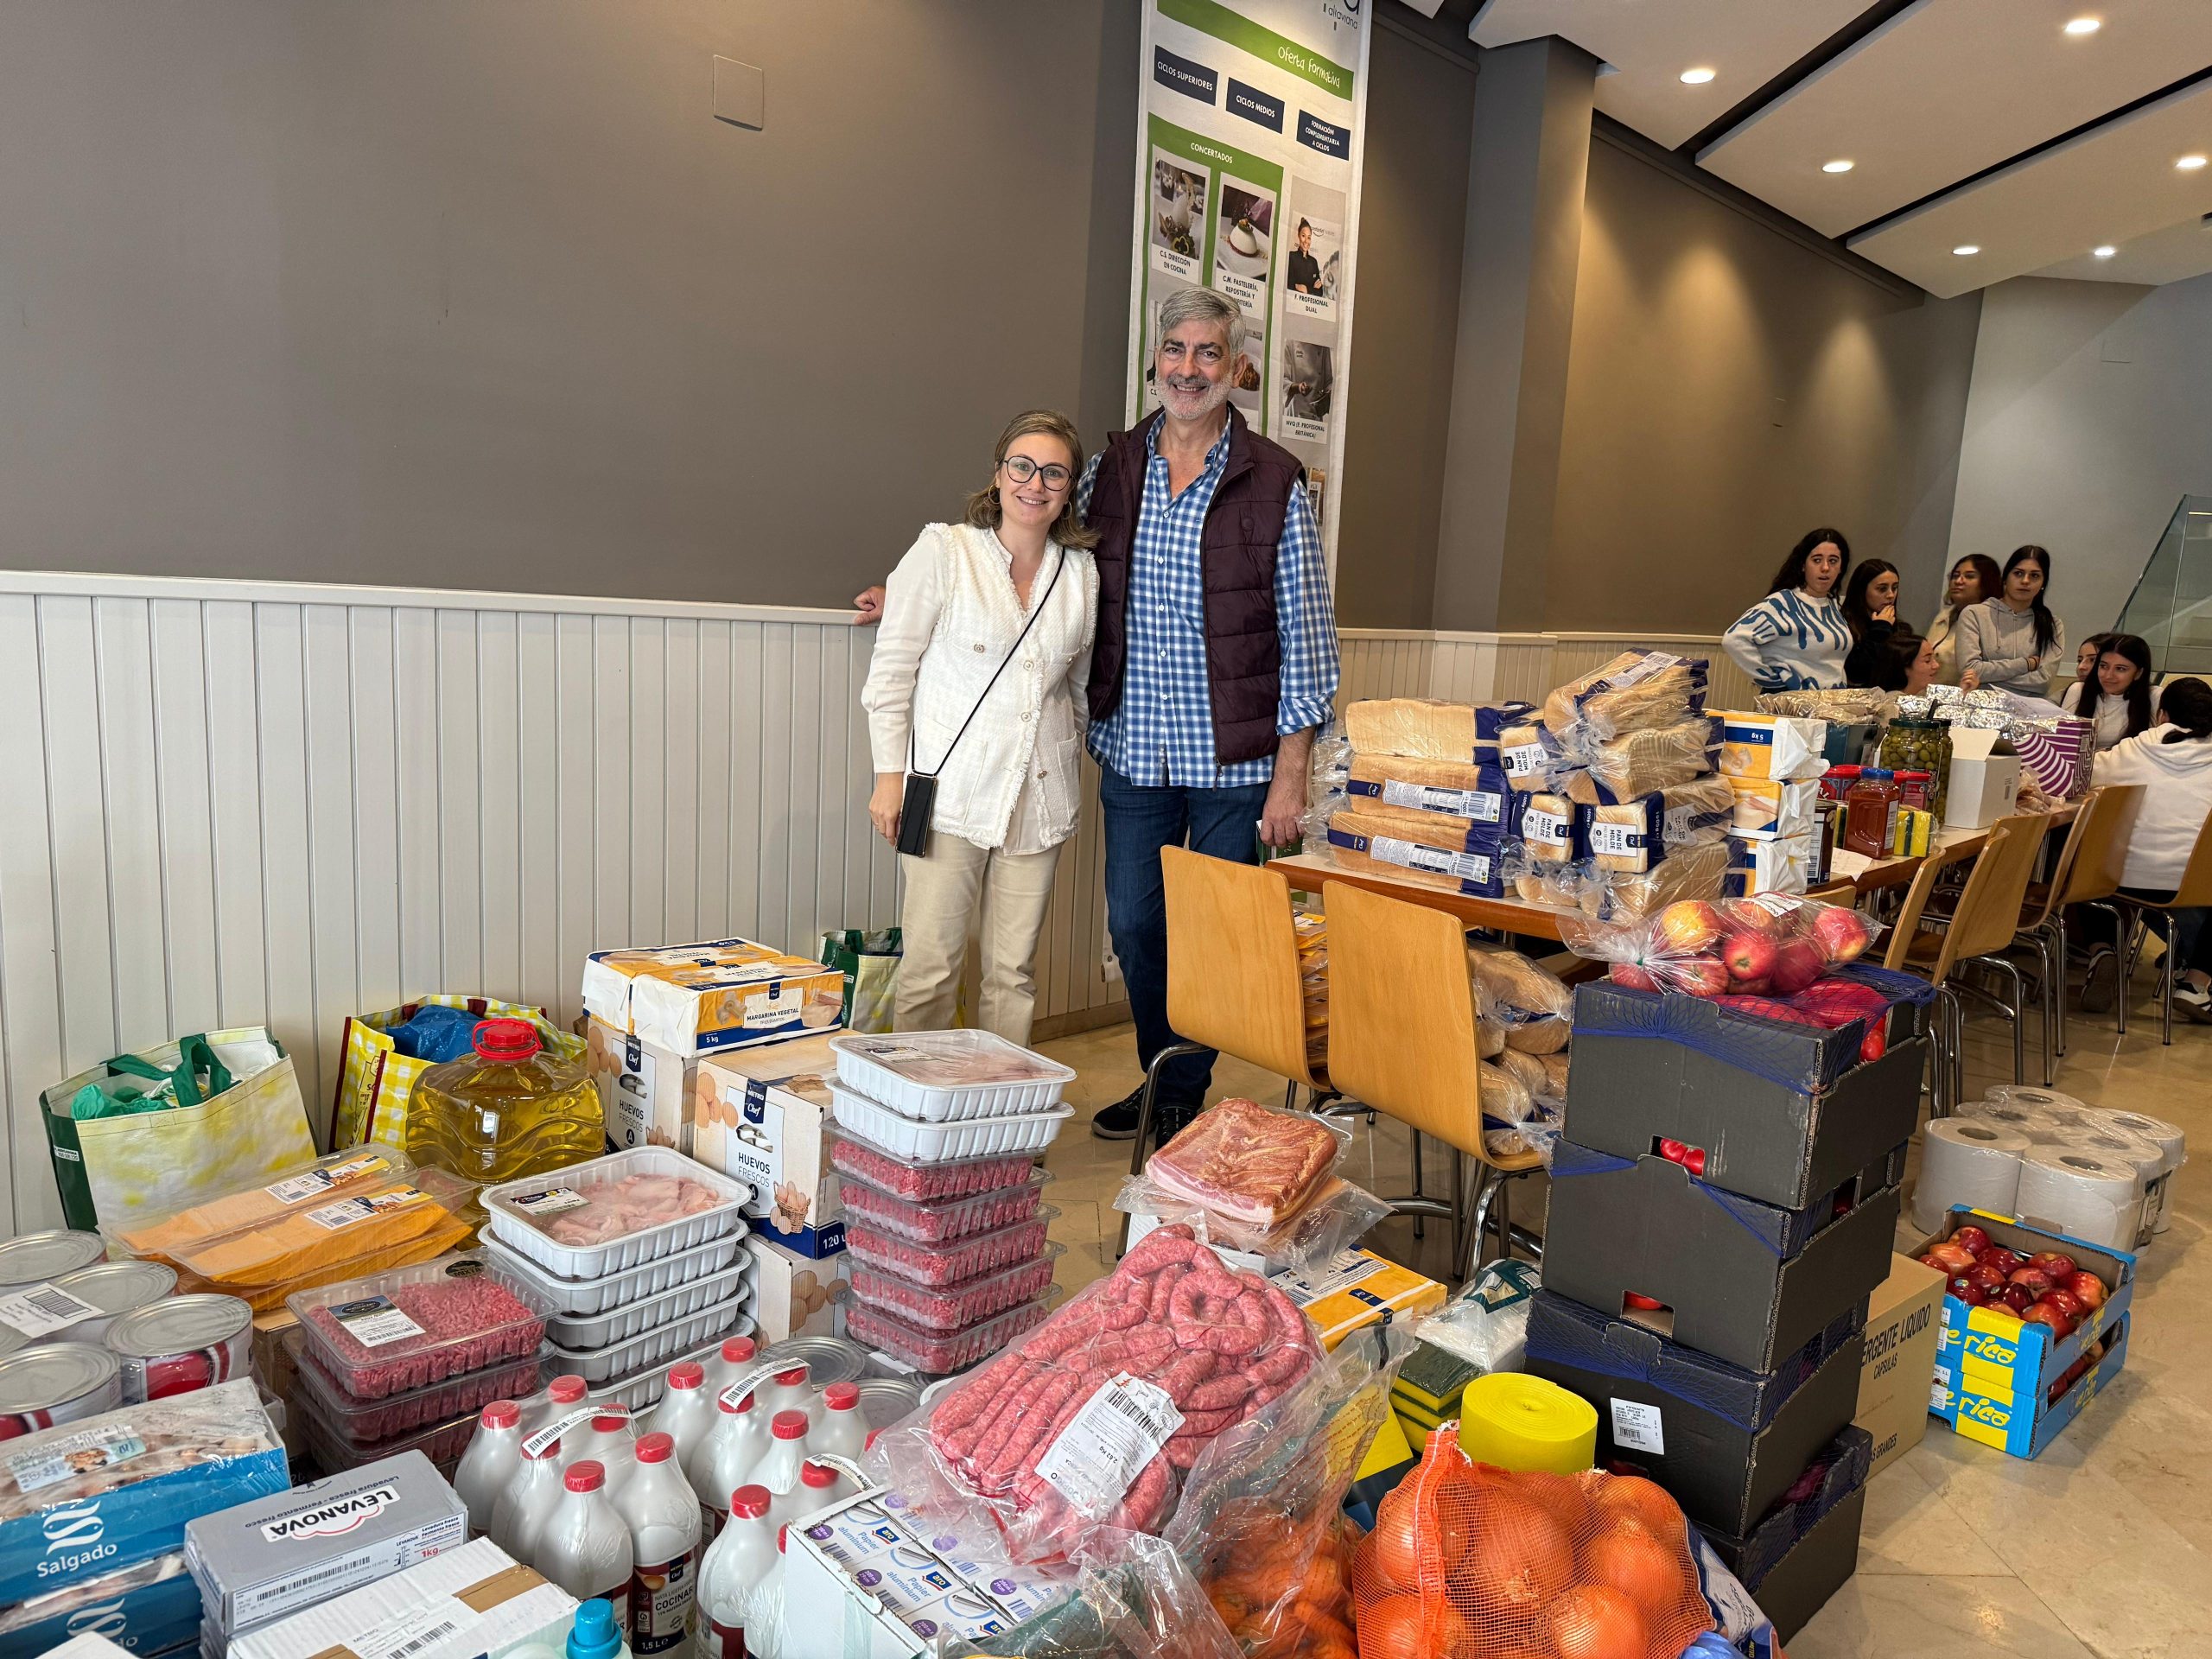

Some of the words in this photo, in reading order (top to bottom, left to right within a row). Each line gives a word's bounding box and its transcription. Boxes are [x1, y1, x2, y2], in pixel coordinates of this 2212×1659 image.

[1278, 47, 1305, 71] Oferta
[1157, 60, 1176, 77] CICLOS
[1177, 70, 1213, 91] SUPERIORES
[1236, 94, 1255, 109] CICLOS
[1255, 103, 1275, 118] MEDIOS
[1311, 120, 1335, 136] FORMACIÓN
[1305, 127, 1340, 147] COMPLEMENTARIA
[1191, 142, 1233, 164] CONCERTADOS
[1315, 141, 1330, 152] CICLOS
[1168, 252, 1191, 268] DIRECCIÓN
[1170, 263, 1187, 276] COCINA
[1225, 286, 1251, 299] REPOSTERÍA
[1299, 295, 1329, 308] PROFESIONAL
[1305, 305, 1318, 314] DUAL
[1616, 842, 1623, 850] DE
[747, 1010, 777, 1021] MARGARINA
[778, 1007, 798, 1017] VEGETAL
[627, 1041, 640, 1052] METRO
[629, 1052, 639, 1066] Chef
[747, 1089, 765, 1101] METRO
[619, 1099, 645, 1120] HUEVOS
[747, 1103, 762, 1116] Chef
[619, 1112, 643, 1132] FRESCOS
[738, 1152, 771, 1174] HUEVOS
[738, 1166, 770, 1187] FRESCOS
[823, 1234, 840, 1249] 120
[1861, 1323, 1899, 1367] ERGENTE
[1899, 1303, 1931, 1344] LIQUIDO
[1946, 1329, 1961, 1344] e
[1963, 1335, 2017, 1363] rica
[1873, 1352, 1898, 1381] CAPSULAS
[1944, 1391, 1956, 1406] e
[1958, 1396, 2011, 1427] rica
[1098, 1446, 1107, 1455] Kg
[1876, 1433, 1898, 1459] GRANDES
[1106, 1452, 1118, 1464] 2,62
[358, 1476, 399, 1493] Levadura
[329, 1487, 358, 1502] fresca
[269, 1490, 393, 1535] LEVANOVA
[277, 1498, 323, 1519] Fermento
[245, 1514, 276, 1528] fresco
[422, 1522, 444, 1531] Levadura
[422, 1526, 444, 1536] Fermento
[881, 1529, 895, 1540] aro
[396, 1535, 418, 1547] LEVANOVA
[838, 1526, 869, 1554] aluminium
[859, 1531, 880, 1550] Papier
[422, 1548, 439, 1557] 1kg
[36, 1544, 118, 1578] Salgado
[671, 1571, 681, 1580] Chef
[931, 1574, 945, 1586] aro
[655, 1593, 669, 1602] NATA
[669, 1586, 684, 1599] LIGERA
[887, 1571, 921, 1603] aluminium
[907, 1576, 931, 1598] Papier
[1021, 1581, 1046, 1602] alumin
[641, 1642, 653, 1650] 1,5
